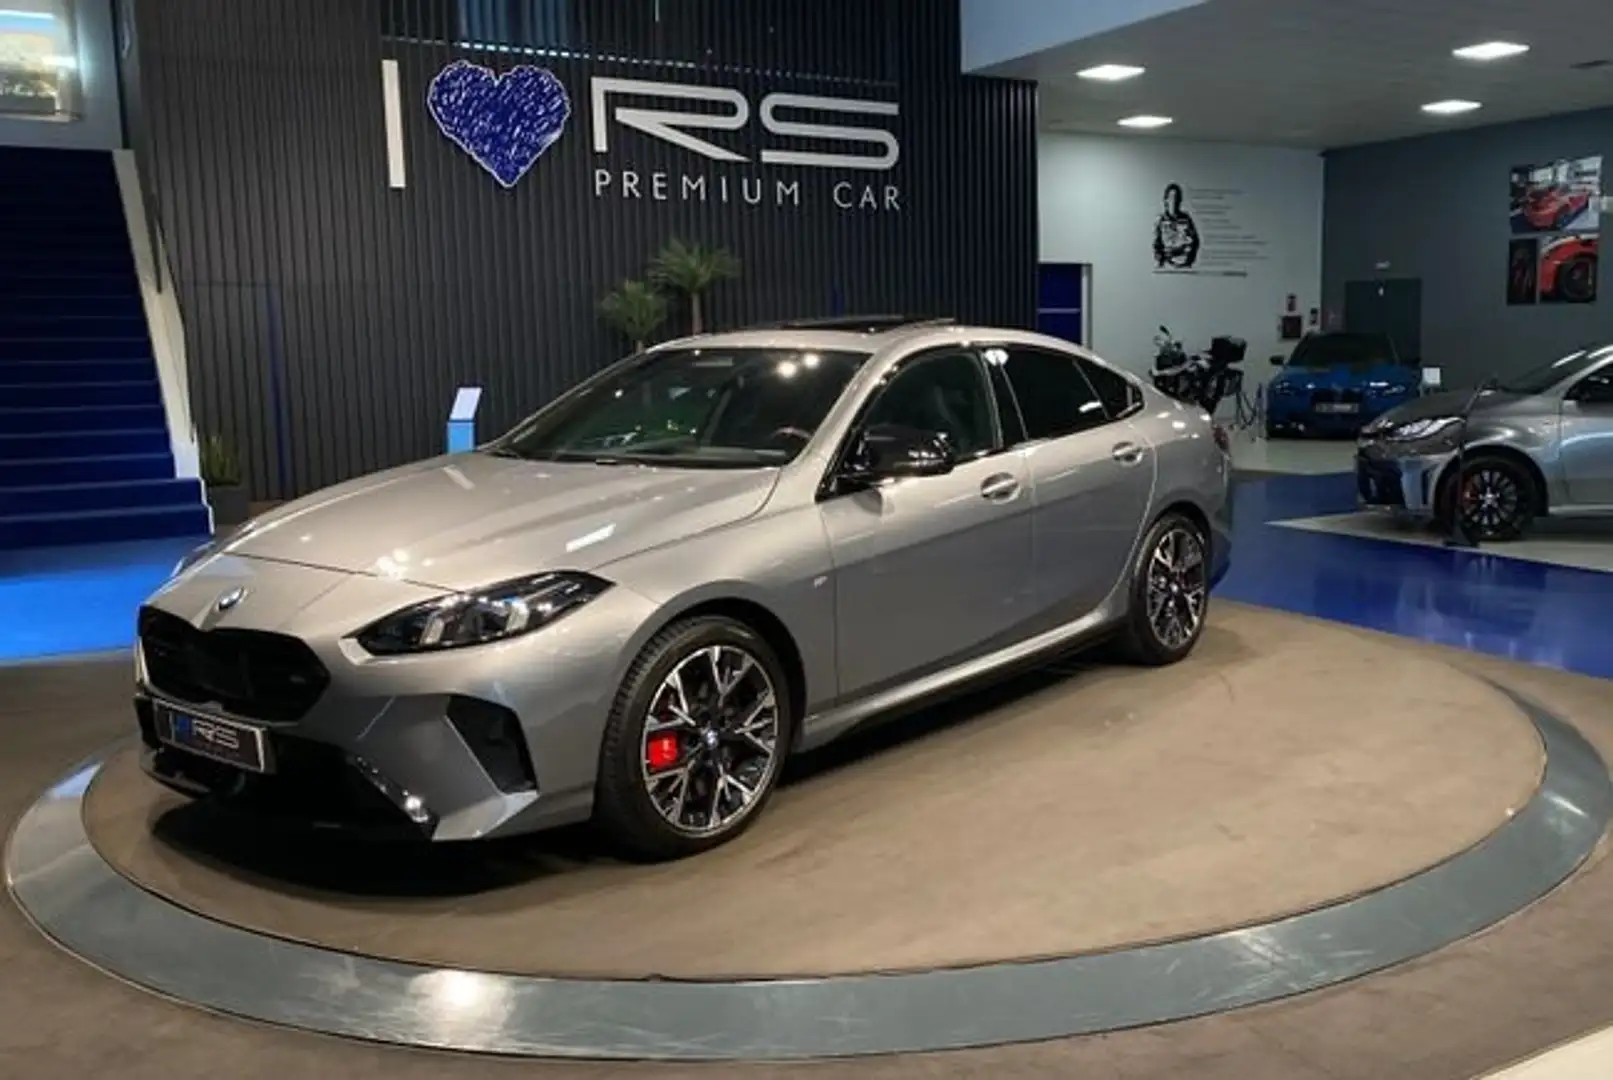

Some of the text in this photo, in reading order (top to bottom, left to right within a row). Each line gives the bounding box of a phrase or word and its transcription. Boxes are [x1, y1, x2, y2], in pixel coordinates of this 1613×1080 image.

[591, 77, 900, 170] RS
[595, 168, 901, 211] PREMIUM CAR
